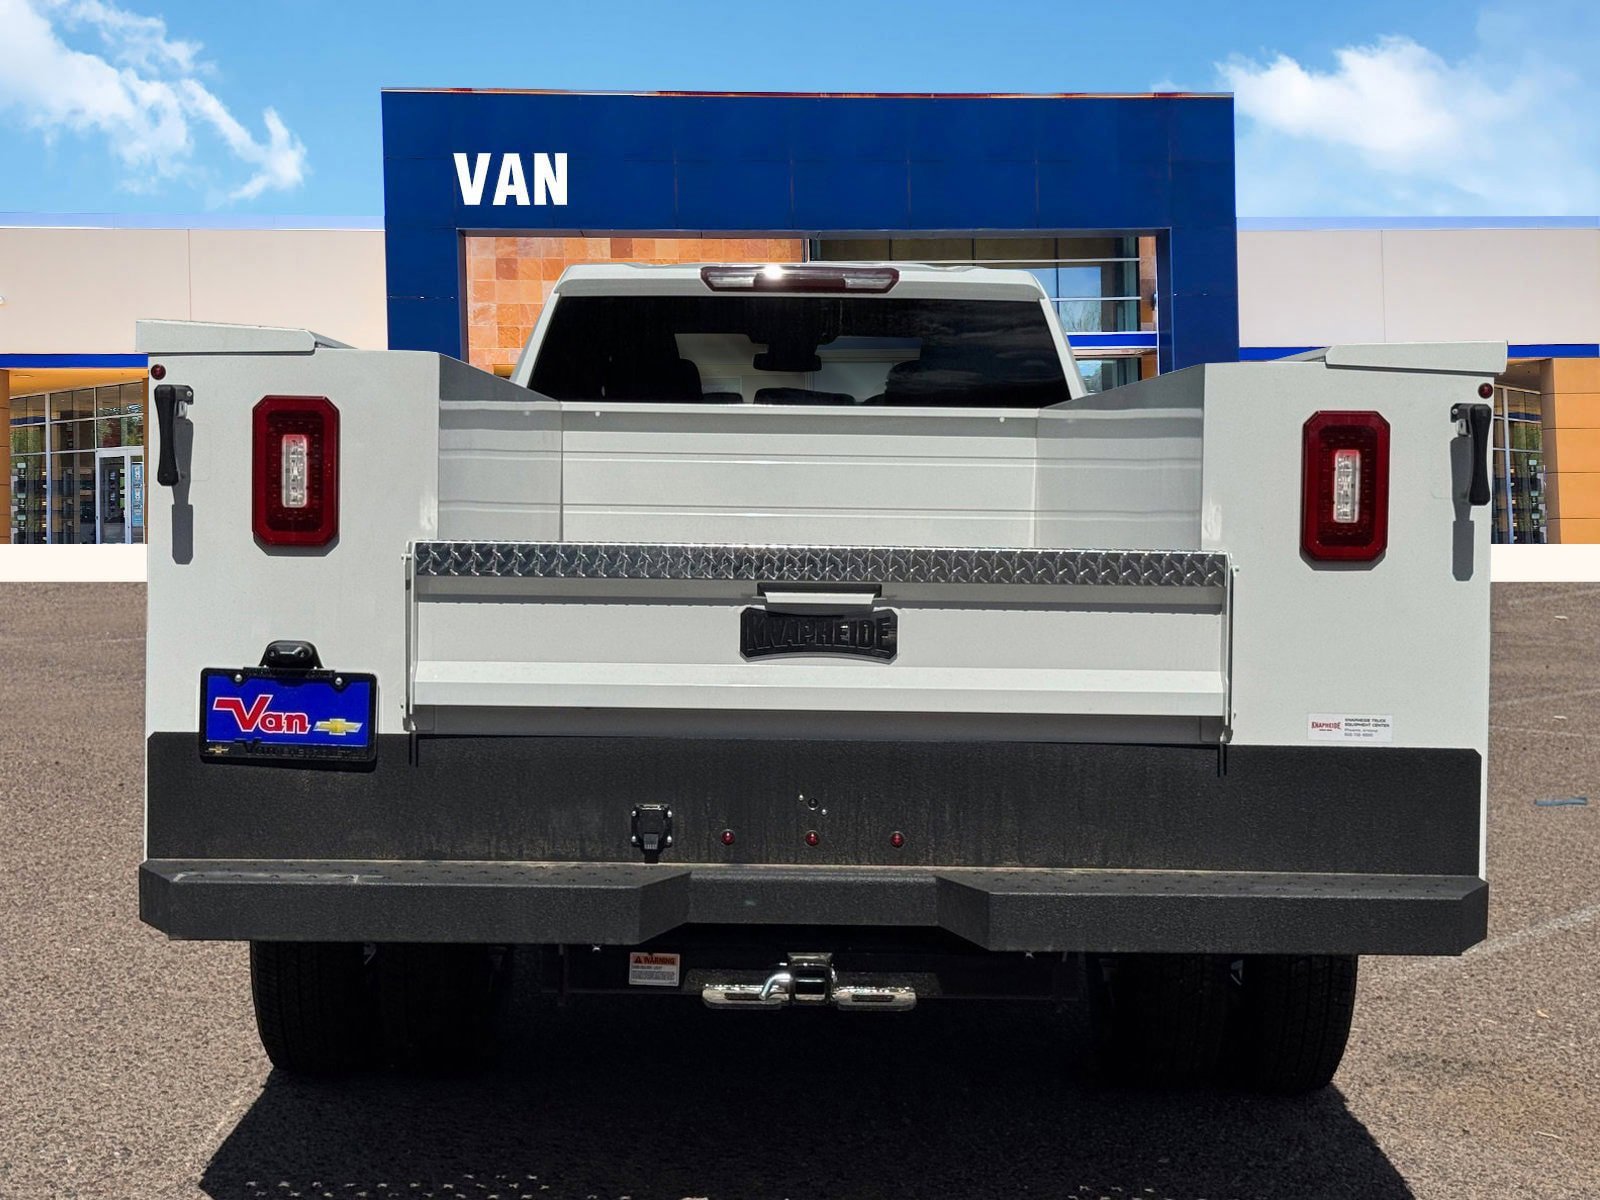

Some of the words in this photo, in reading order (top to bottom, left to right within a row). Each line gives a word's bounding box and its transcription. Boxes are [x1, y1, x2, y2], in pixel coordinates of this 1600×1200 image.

[452, 152, 568, 206] VAN
[744, 612, 891, 653] KNAPHEIDE
[213, 693, 312, 734] Van
[1311, 721, 1341, 729] KNAPHEIDE
[643, 956, 675, 965] WARNING
